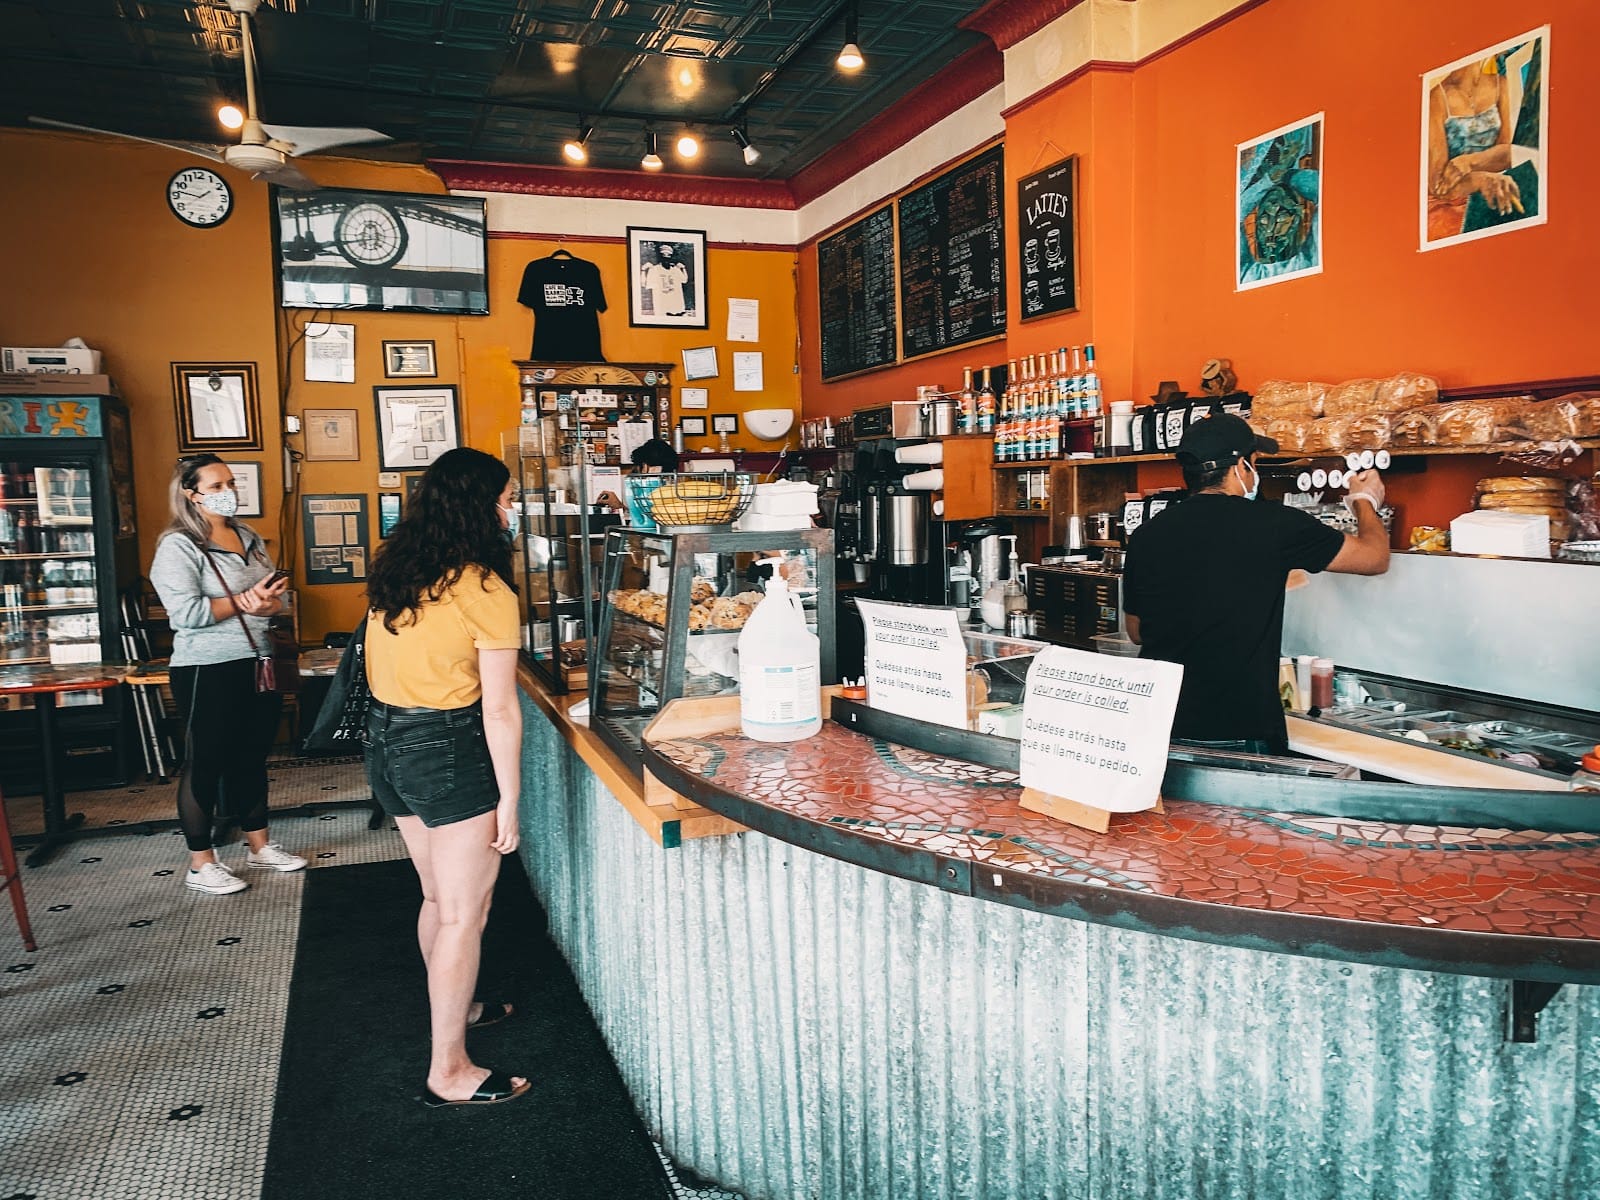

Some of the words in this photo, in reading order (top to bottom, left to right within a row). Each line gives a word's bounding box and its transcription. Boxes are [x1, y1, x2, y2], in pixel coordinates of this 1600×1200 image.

[192, 172, 204, 180] 12
[178, 203, 185, 211] 8
[220, 194, 227, 202] 3
[1026, 193, 1068, 225] LATTES
[198, 214, 206, 224] 6
[872, 616, 892, 626] Please
[893, 620, 912, 630] stand
[912, 623, 929, 632] back
[931, 626, 948, 635] until
[876, 632, 889, 641] your
[891, 633, 908, 644] order
[918, 637, 940, 649] called.
[923, 669, 942, 681] hasta
[1037, 664, 1066, 678] Please
[1068, 670, 1097, 684] stand
[1100, 675, 1124, 689] back
[1127, 682, 1154, 694] until
[876, 676, 887, 686] que
[897, 678, 914, 690] llame
[916, 684, 924, 693] su
[926, 686, 954, 699] pedido.
[1033, 684, 1053, 695] your
[1056, 686, 1082, 700] order
[1084, 691, 1092, 703] is
[1094, 695, 1129, 711] called.
[1068, 730, 1096, 744] atrás
[1098, 734, 1126, 752] hasta
[1022, 738, 1038, 750] que
[1040, 742, 1051, 753] se
[1054, 744, 1082, 761] llame
[1084, 754, 1096, 765] su
[1100, 758, 1142, 776] pedido.
